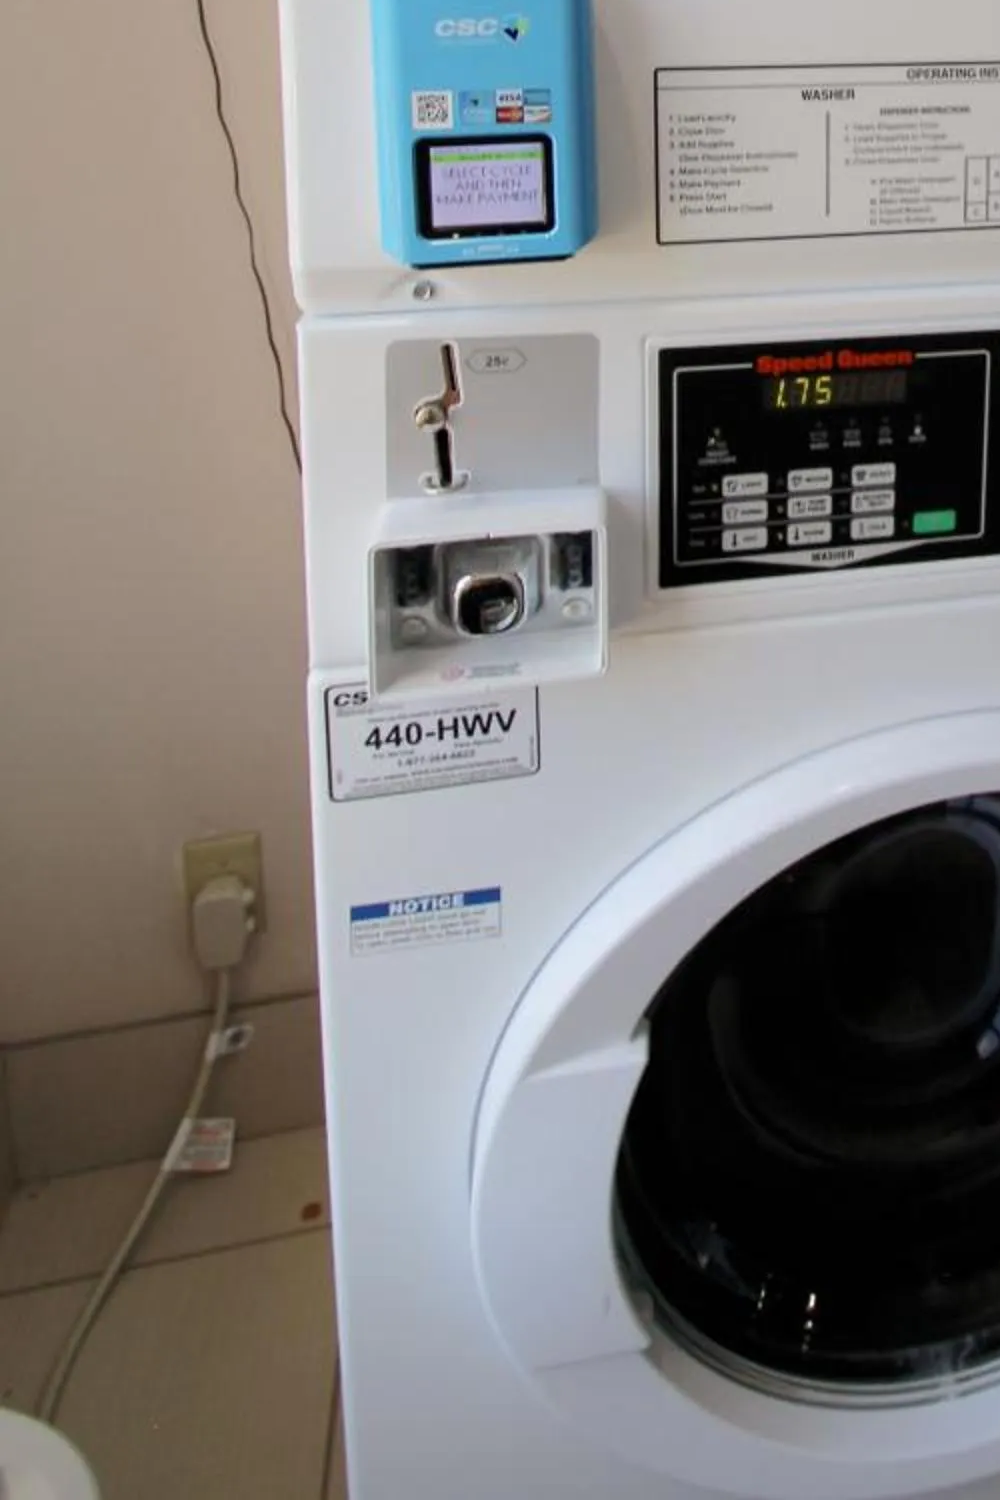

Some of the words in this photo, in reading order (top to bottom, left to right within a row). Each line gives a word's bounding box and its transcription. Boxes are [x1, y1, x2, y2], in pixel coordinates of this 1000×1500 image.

[434, 18, 498, 38] CSC
[907, 67, 977, 80] OPERATING
[802, 89, 855, 102] WASHER
[477, 189, 538, 204] PAYMENT
[756, 351, 833, 375] Speed
[837, 348, 914, 370] Queen
[775, 376, 832, 408] 1.75
[811, 549, 855, 562] WASHER
[333, 691, 369, 708] CS
[365, 708, 517, 750] 440-HWV
[389, 893, 464, 916] NOTICE
